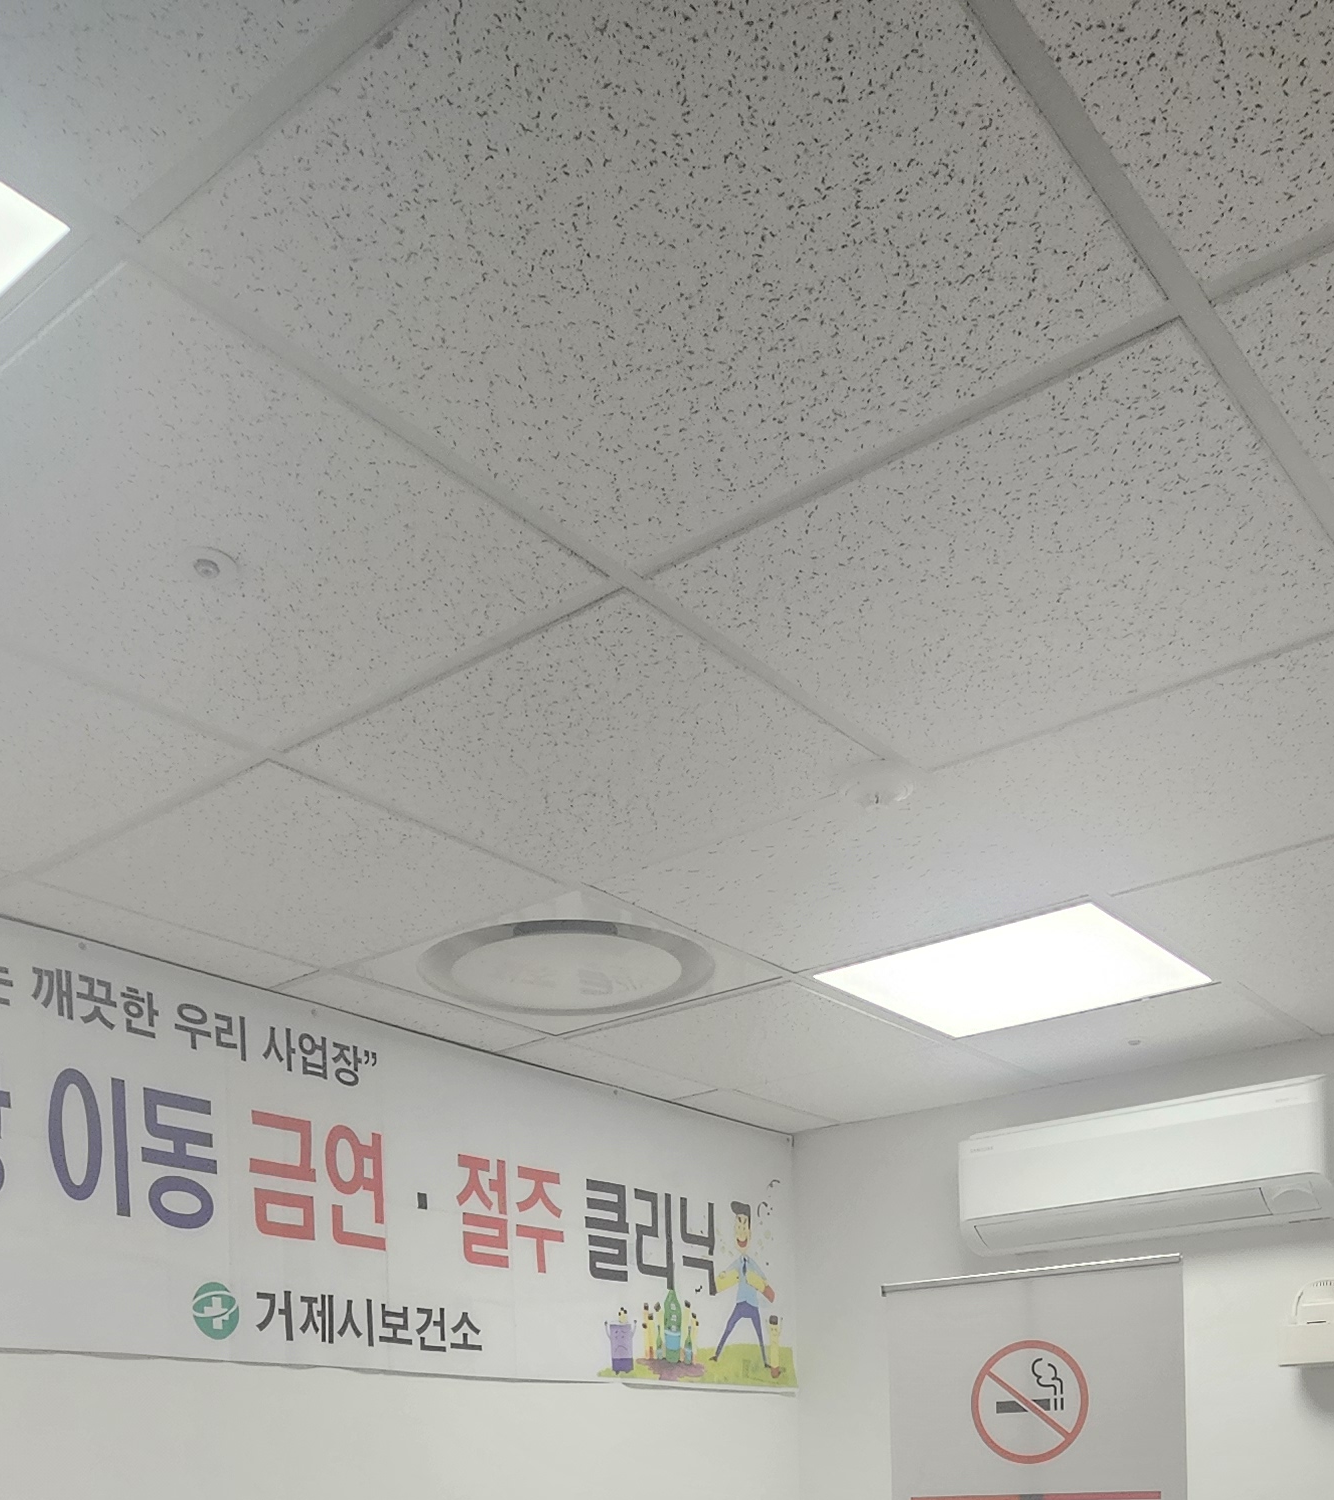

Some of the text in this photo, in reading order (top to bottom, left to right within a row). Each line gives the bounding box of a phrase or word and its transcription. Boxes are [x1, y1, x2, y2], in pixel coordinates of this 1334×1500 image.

[31, 965, 159, 1040] 깨끗한
[173, 1000, 248, 1062] 우리
[261, 1026, 378, 1088] 사업장”
[48, 1066, 218, 1230] 이동
[248, 1108, 387, 1252] 금연
[455, 1152, 566, 1274] 절주
[585, 1177, 718, 1297] 클리닉
[255, 1289, 484, 1354] 거제시보건소
